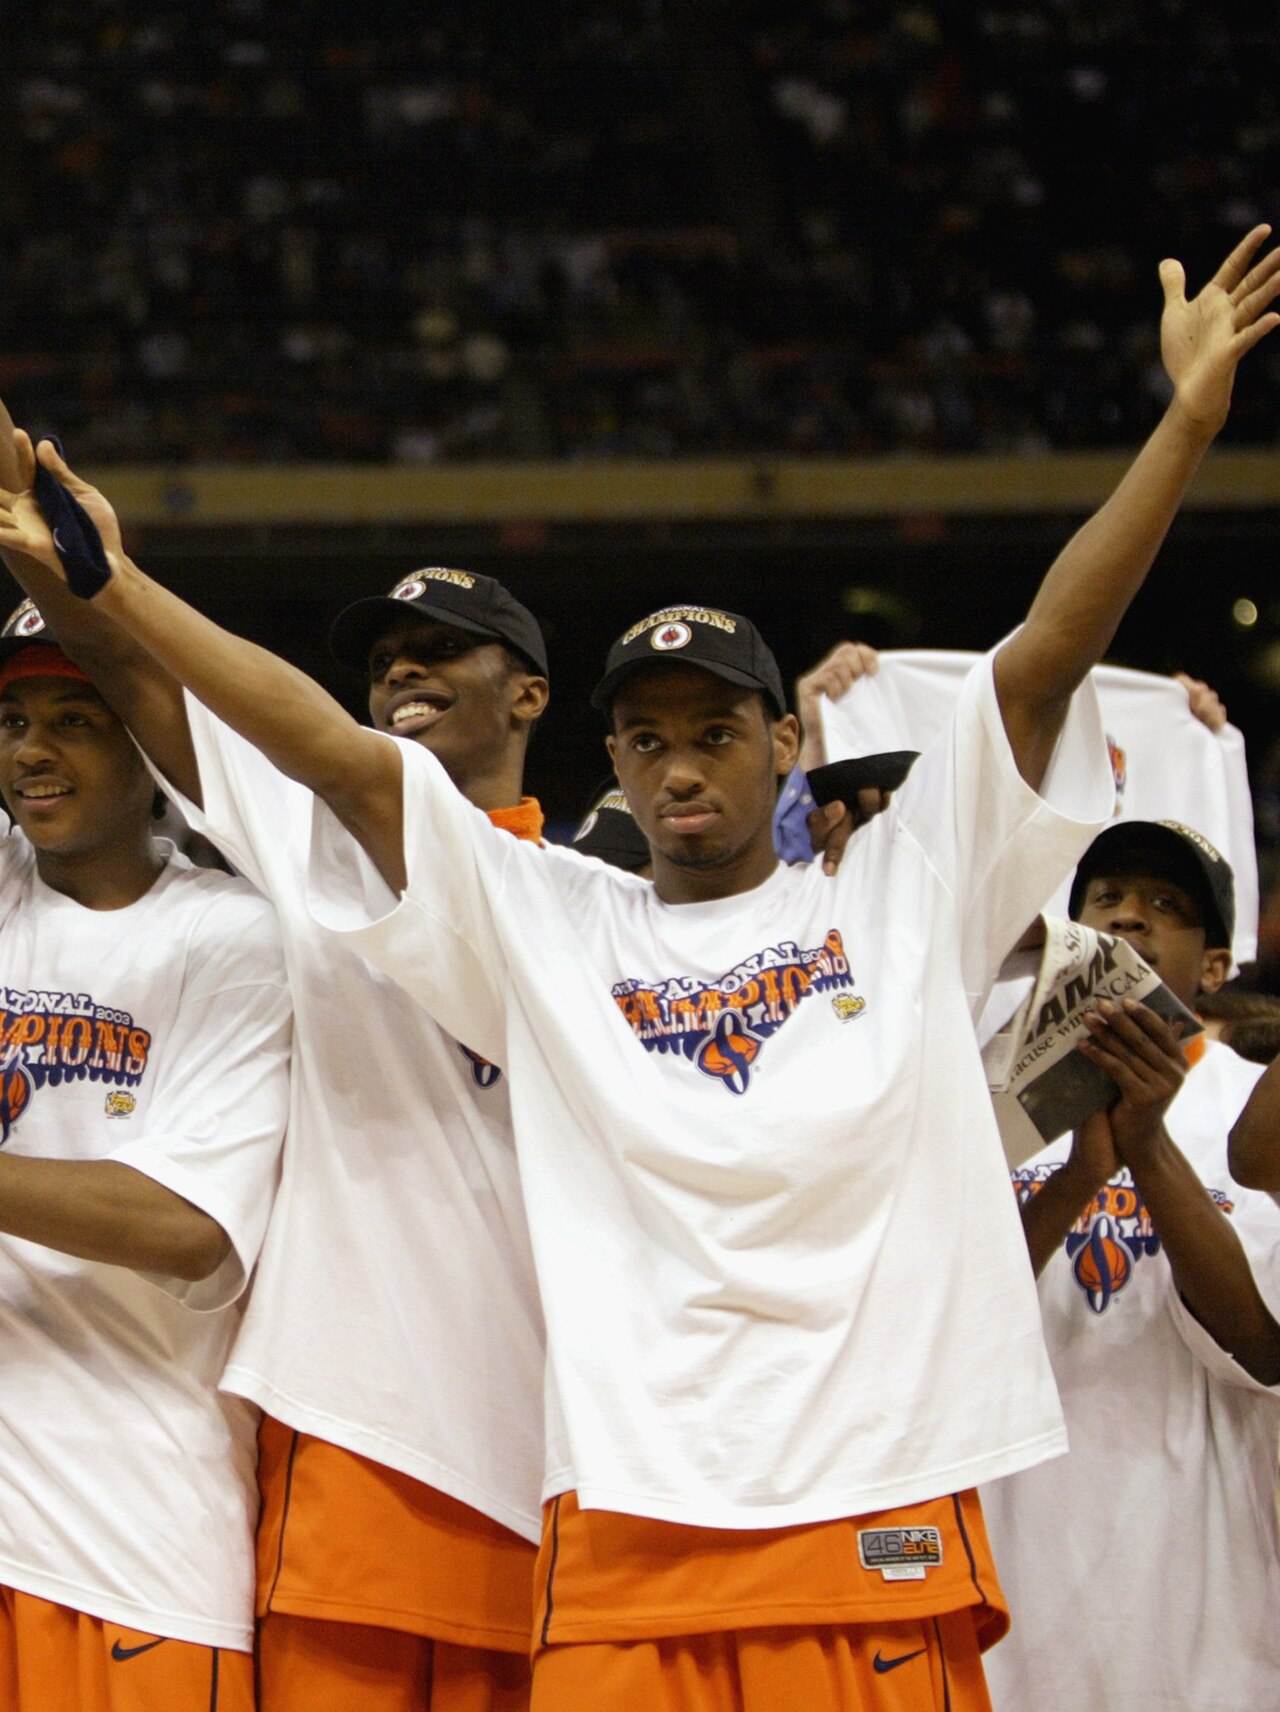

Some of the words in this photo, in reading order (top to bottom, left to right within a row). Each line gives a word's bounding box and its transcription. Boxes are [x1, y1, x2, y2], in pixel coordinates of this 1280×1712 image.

[621, 610, 738, 645] CHAMPIONS
[1093, 962, 1152, 1003] NCAA
[95, 1006, 132, 1026] 2003
[866, 1533, 902, 1555] 46
[901, 1529, 938, 1542] NIKE
